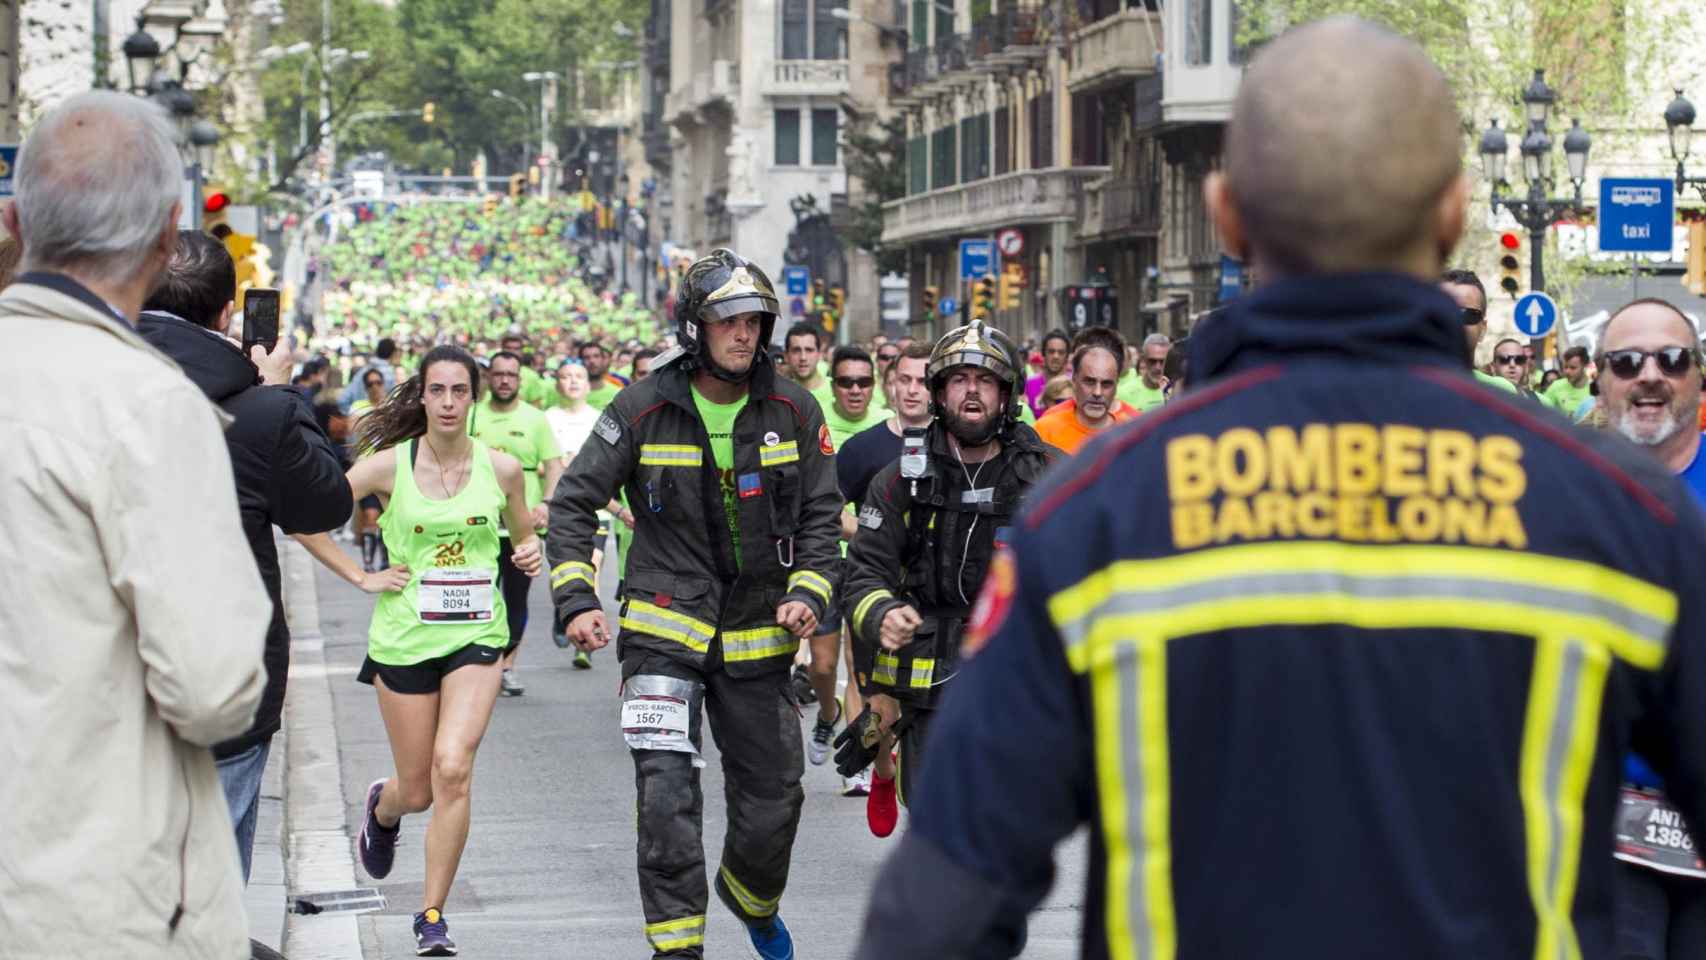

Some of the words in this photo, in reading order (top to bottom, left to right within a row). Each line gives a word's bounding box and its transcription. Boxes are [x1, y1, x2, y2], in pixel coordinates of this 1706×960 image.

[1622, 223, 1650, 239] taxi
[1166, 422, 1528, 502] BOMBERS
[1171, 492, 1529, 549] BARCELONA
[435, 540, 464, 558] 20
[442, 589, 471, 597] NADIA
[442, 599, 471, 609] 8094
[636, 712, 664, 725] 1567
[1648, 808, 1686, 828] ANT
